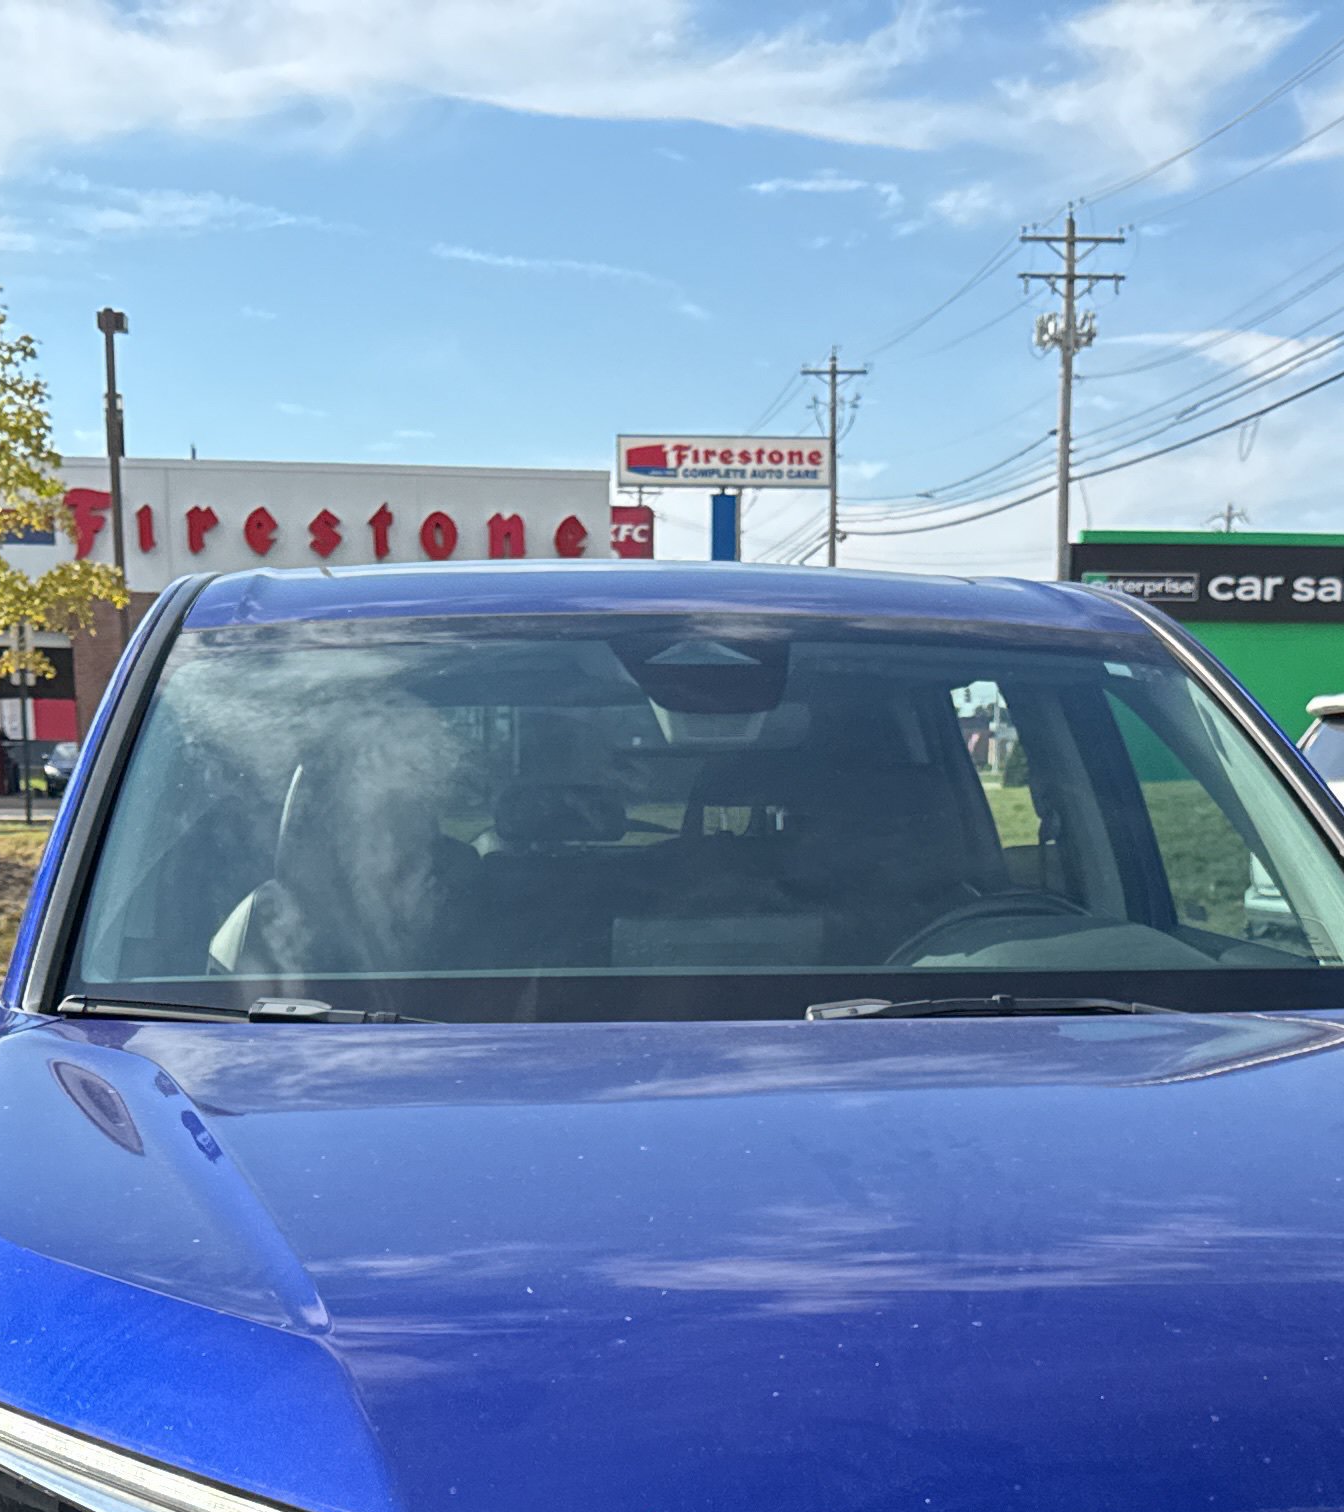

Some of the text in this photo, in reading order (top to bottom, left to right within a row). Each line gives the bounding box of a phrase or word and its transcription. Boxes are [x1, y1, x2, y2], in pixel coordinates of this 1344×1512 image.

[672, 443, 822, 468] Firestone
[682, 468, 746, 479] COMPLETE
[751, 469, 783, 479] AUTO
[787, 469, 818, 479] CARE
[63, 487, 587, 562] Firestone
[1207, 574, 1285, 601] car
